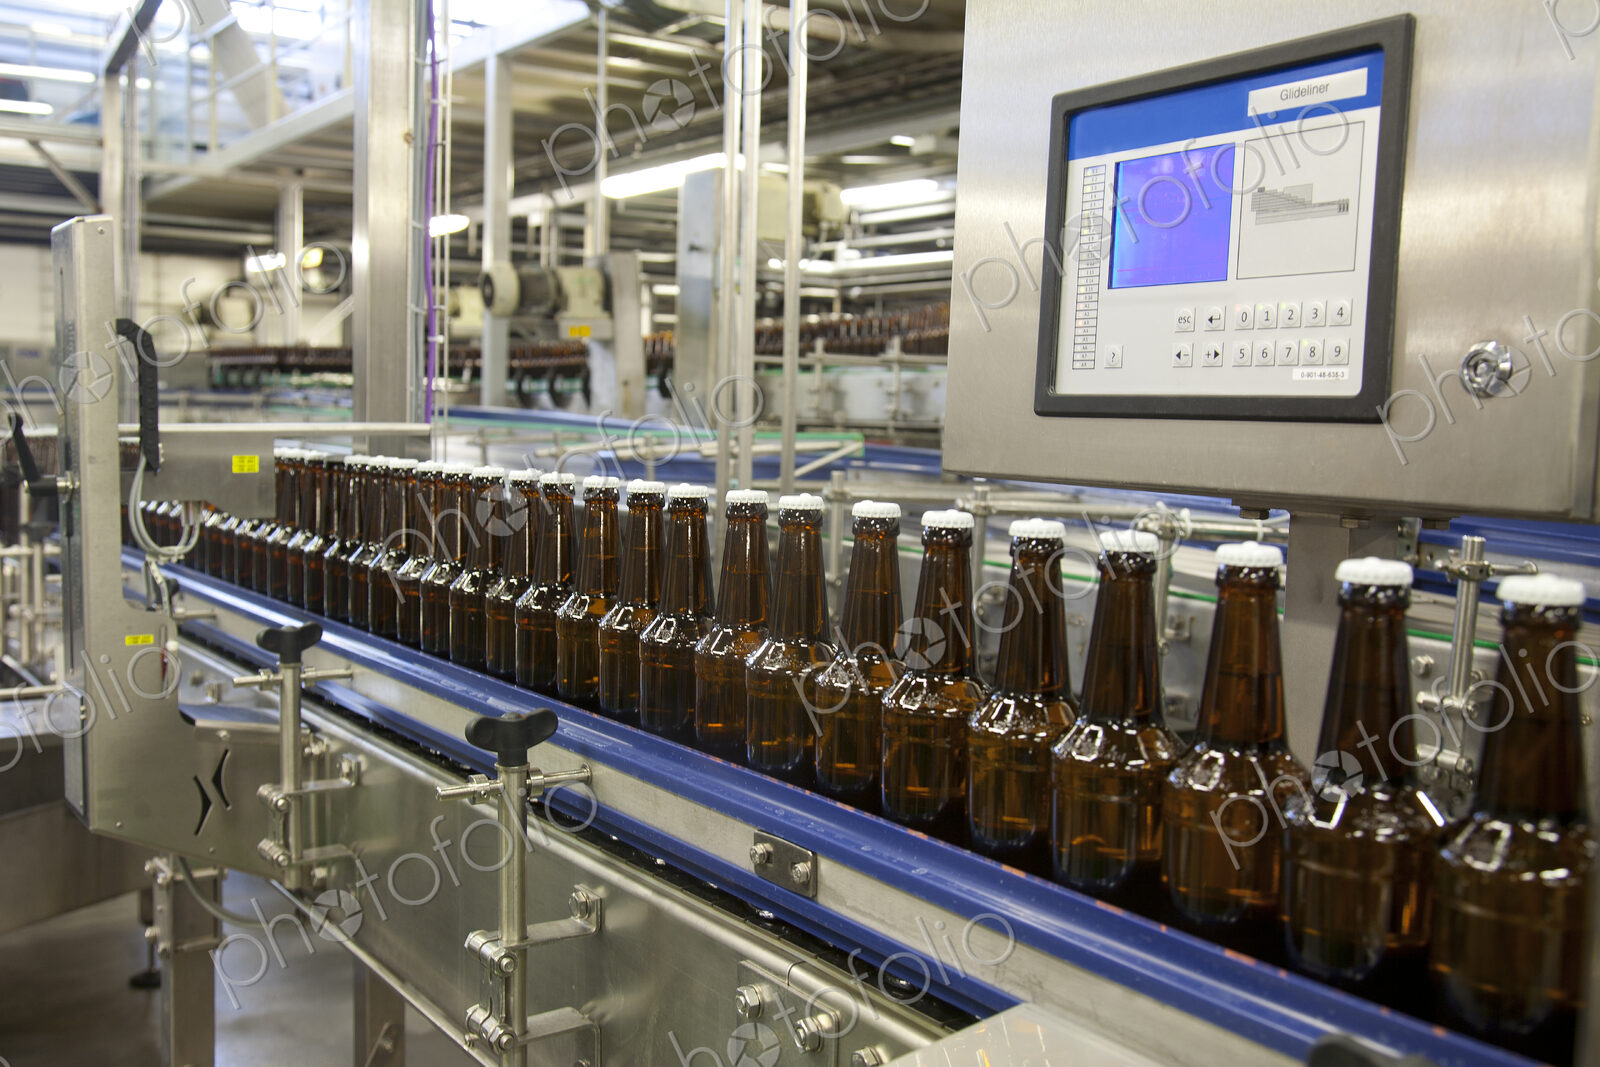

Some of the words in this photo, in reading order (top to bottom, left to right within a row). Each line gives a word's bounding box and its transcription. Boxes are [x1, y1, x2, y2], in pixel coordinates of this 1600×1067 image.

[1280, 82, 1330, 101] Glideliner
[1178, 315, 1191, 324] esc
[1241, 311, 1248, 322] 0
[1264, 311, 1270, 321] 1
[1287, 309, 1294, 320] 2
[1312, 308, 1318, 319] 3
[1337, 307, 1344, 318] 4
[1239, 348, 1245, 359] 5
[1261, 347, 1268, 359] 6
[1285, 347, 1292, 358] 7
[1309, 346, 1316, 358] 8
[1334, 345, 1341, 357] 9
